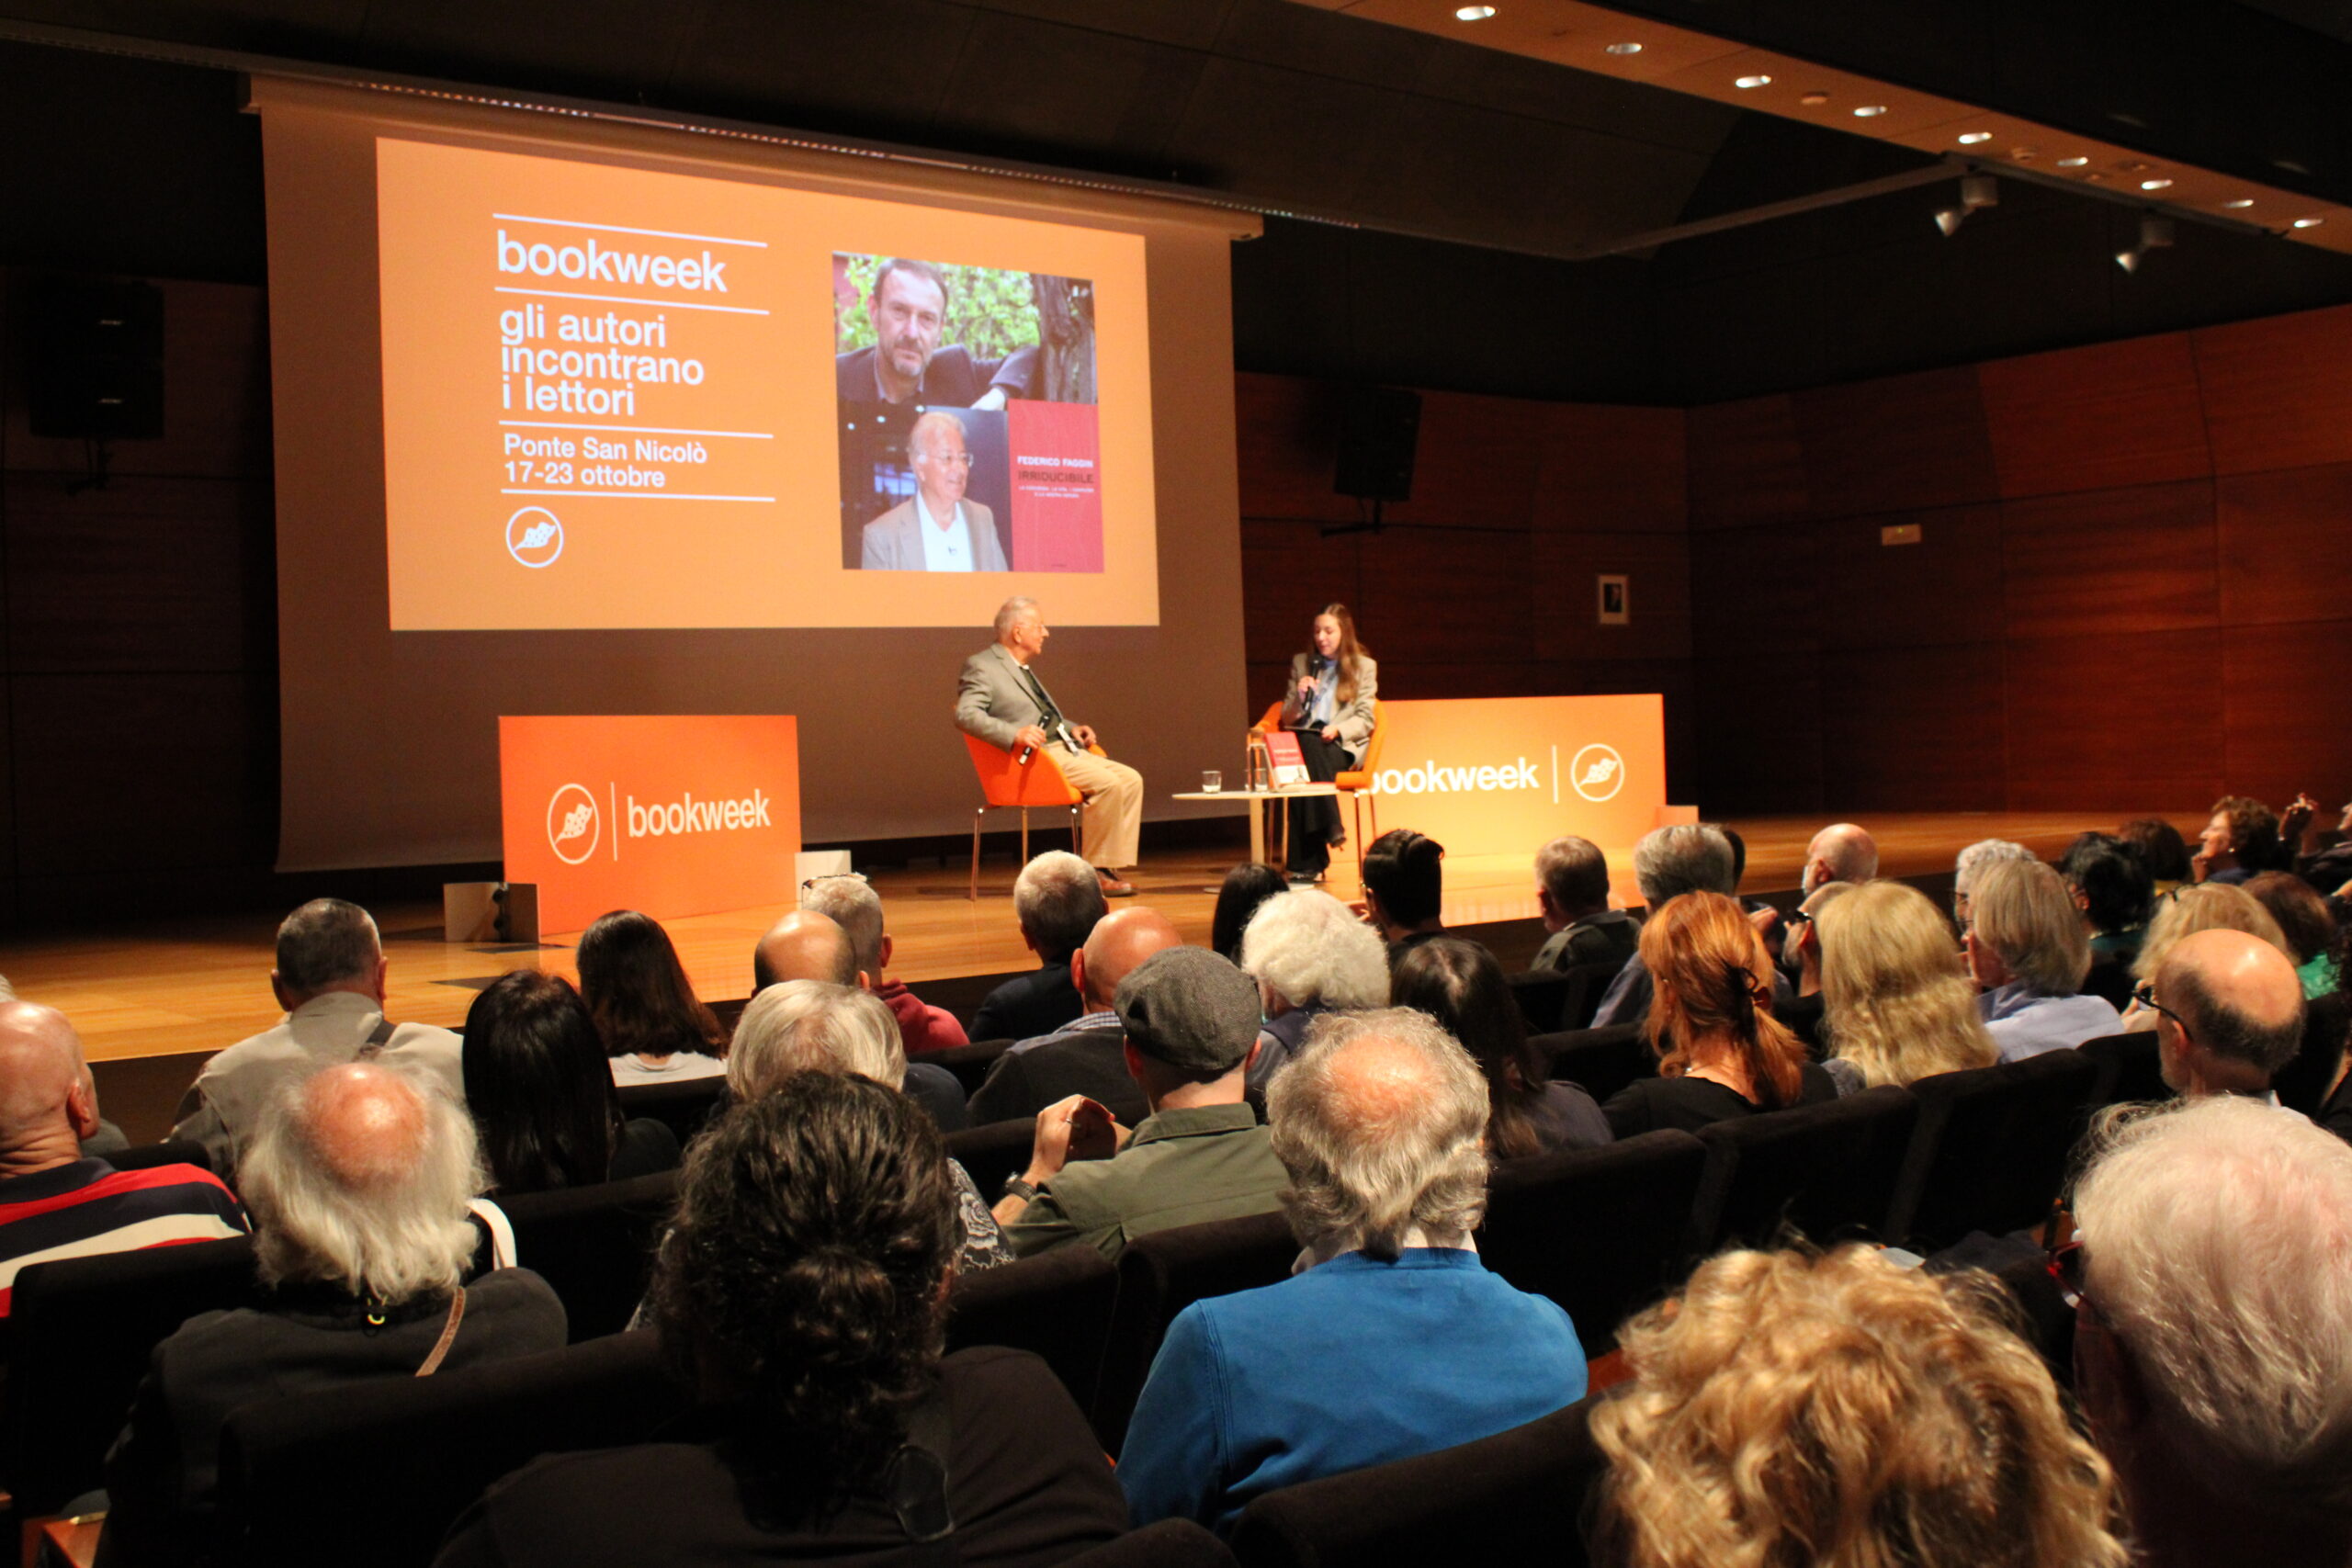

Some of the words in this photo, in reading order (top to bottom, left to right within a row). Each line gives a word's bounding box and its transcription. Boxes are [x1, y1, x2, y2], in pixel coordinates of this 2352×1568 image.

[497, 230, 728, 292] bookweek
[500, 303, 545, 345] gli
[558, 313, 666, 347] autori
[502, 344, 705, 385] incontrano
[503, 375, 511, 410] i
[526, 376, 635, 416] lettori
[504, 434, 576, 458] Ponte
[582, 437, 628, 460] San
[635, 439, 707, 464] Nicolò
[504, 461, 574, 484] 17-23
[581, 465, 666, 488] ottobre
[1018, 470, 1094, 484] IRRIDUCIBILE
[628, 788, 771, 838] bookweek
